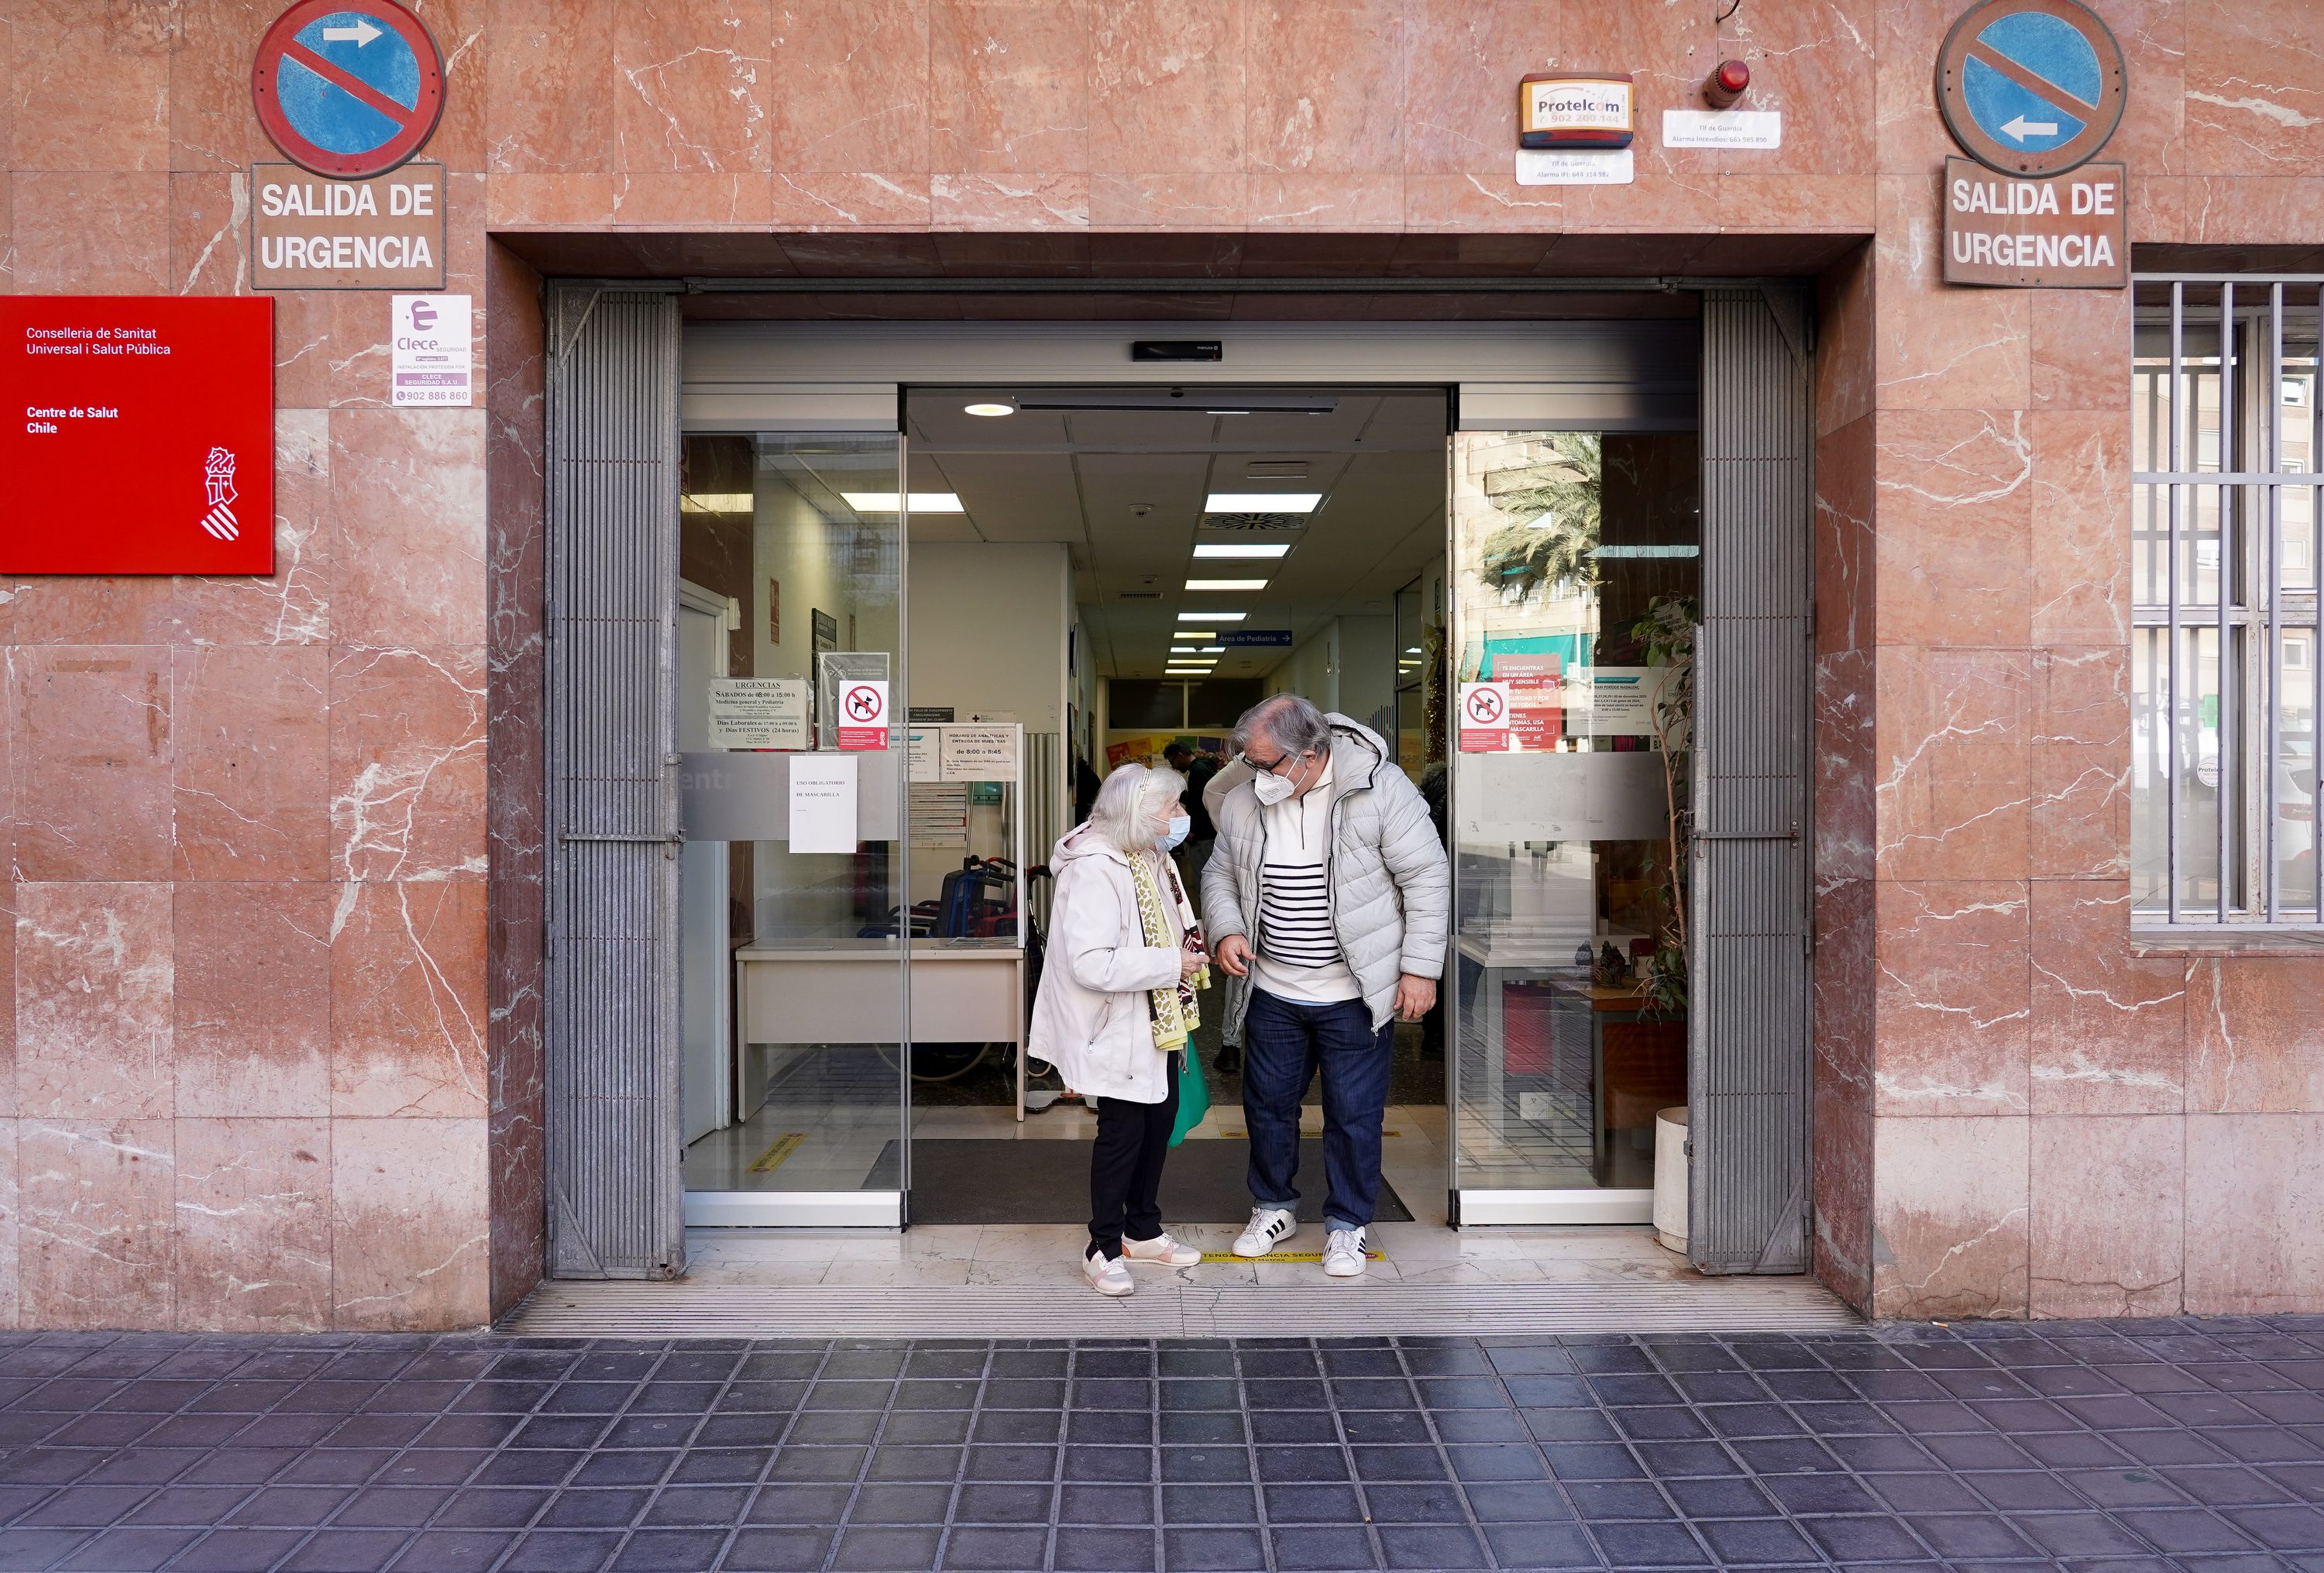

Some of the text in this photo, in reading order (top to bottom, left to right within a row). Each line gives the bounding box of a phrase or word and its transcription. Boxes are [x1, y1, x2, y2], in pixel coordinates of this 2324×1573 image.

[1538, 99, 1620, 113] Protelcom
[1576, 114, 1596, 122] 200
[262, 184, 434, 217] SALIDA DE
[1953, 179, 2115, 216] SALIDA DE
[262, 236, 434, 270] URGENCIA
[1953, 232, 2115, 267] URGENCIA
[26, 327, 156, 339] Conselleria de Sanitat
[26, 343, 170, 355] Universal i Salut Pública
[397, 337, 438, 350] Clece
[26, 407, 118, 418] Centre de Salut
[26, 422, 57, 434] Chile
